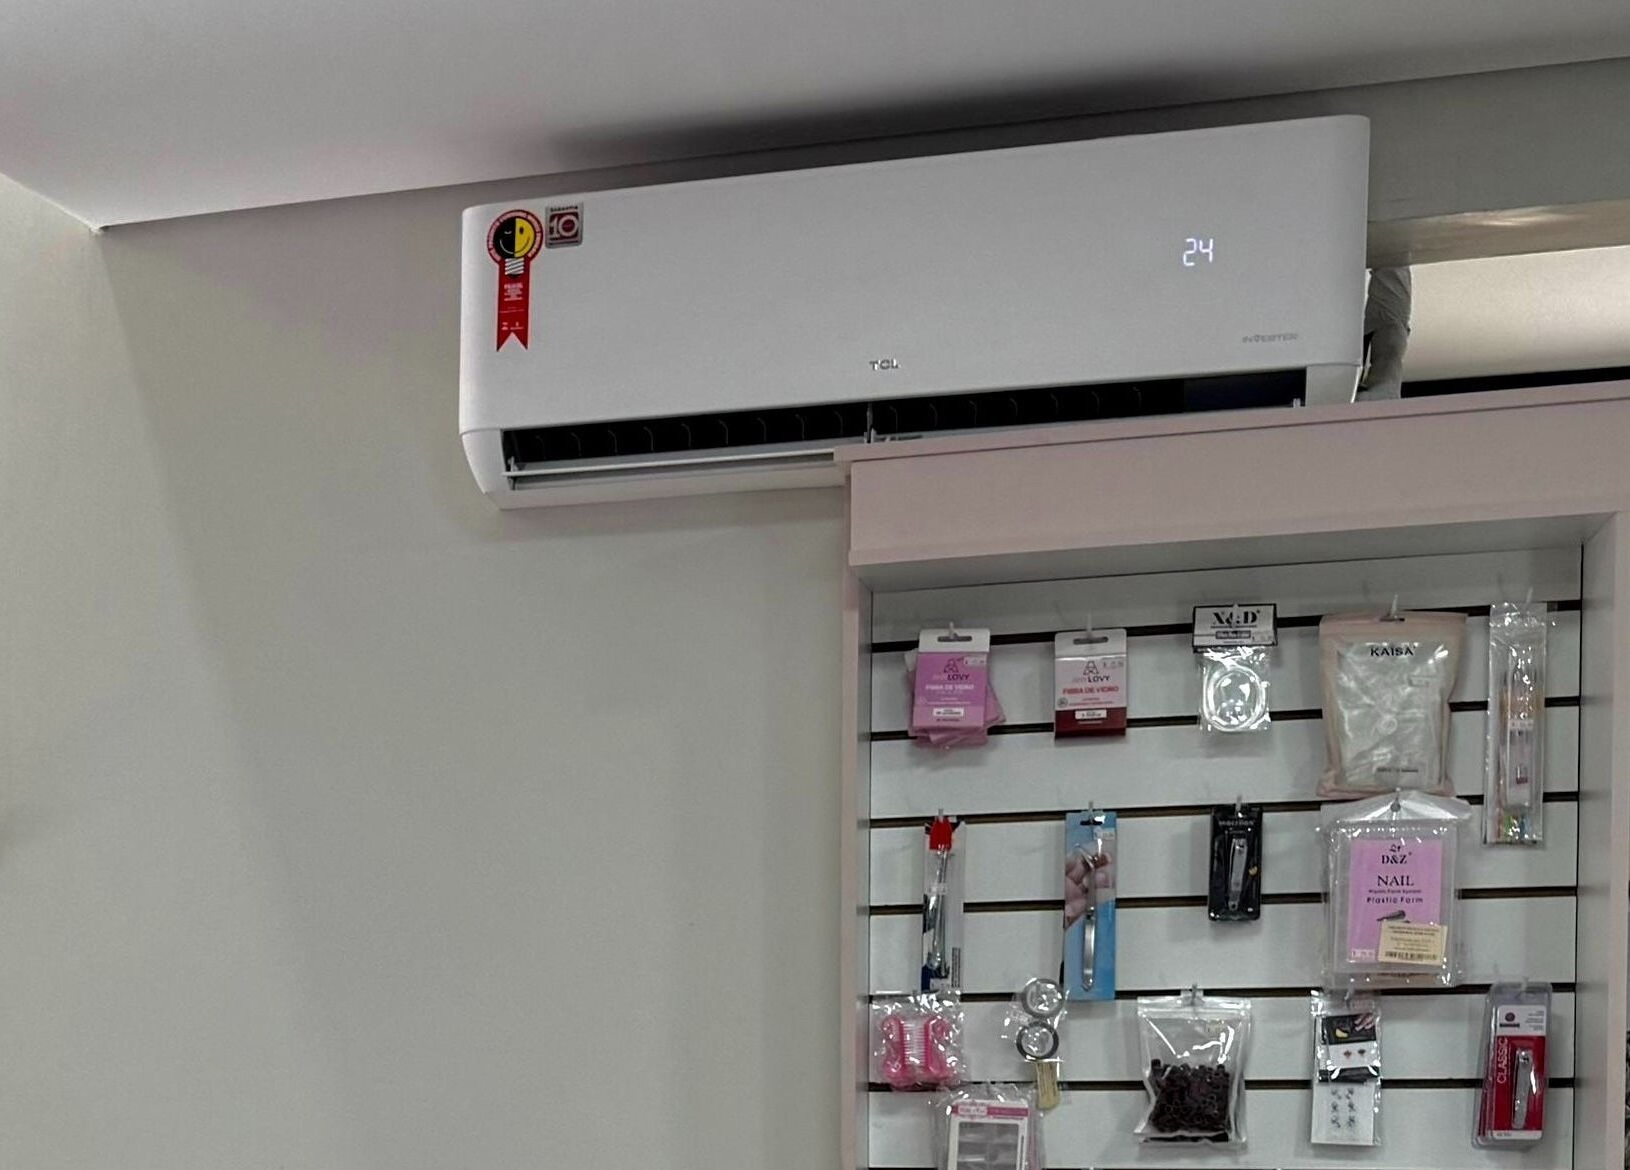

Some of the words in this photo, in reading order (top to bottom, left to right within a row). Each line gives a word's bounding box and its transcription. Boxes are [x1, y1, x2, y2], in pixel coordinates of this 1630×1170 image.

[1182, 238, 1214, 266] 24
[869, 358, 900, 371] TCL
[1370, 646, 1414, 657] KAISA
[1381, 854, 1408, 865] D&Z
[1377, 875, 1414, 887] NAIL
[1496, 1037, 1508, 1084] CLASSIC
